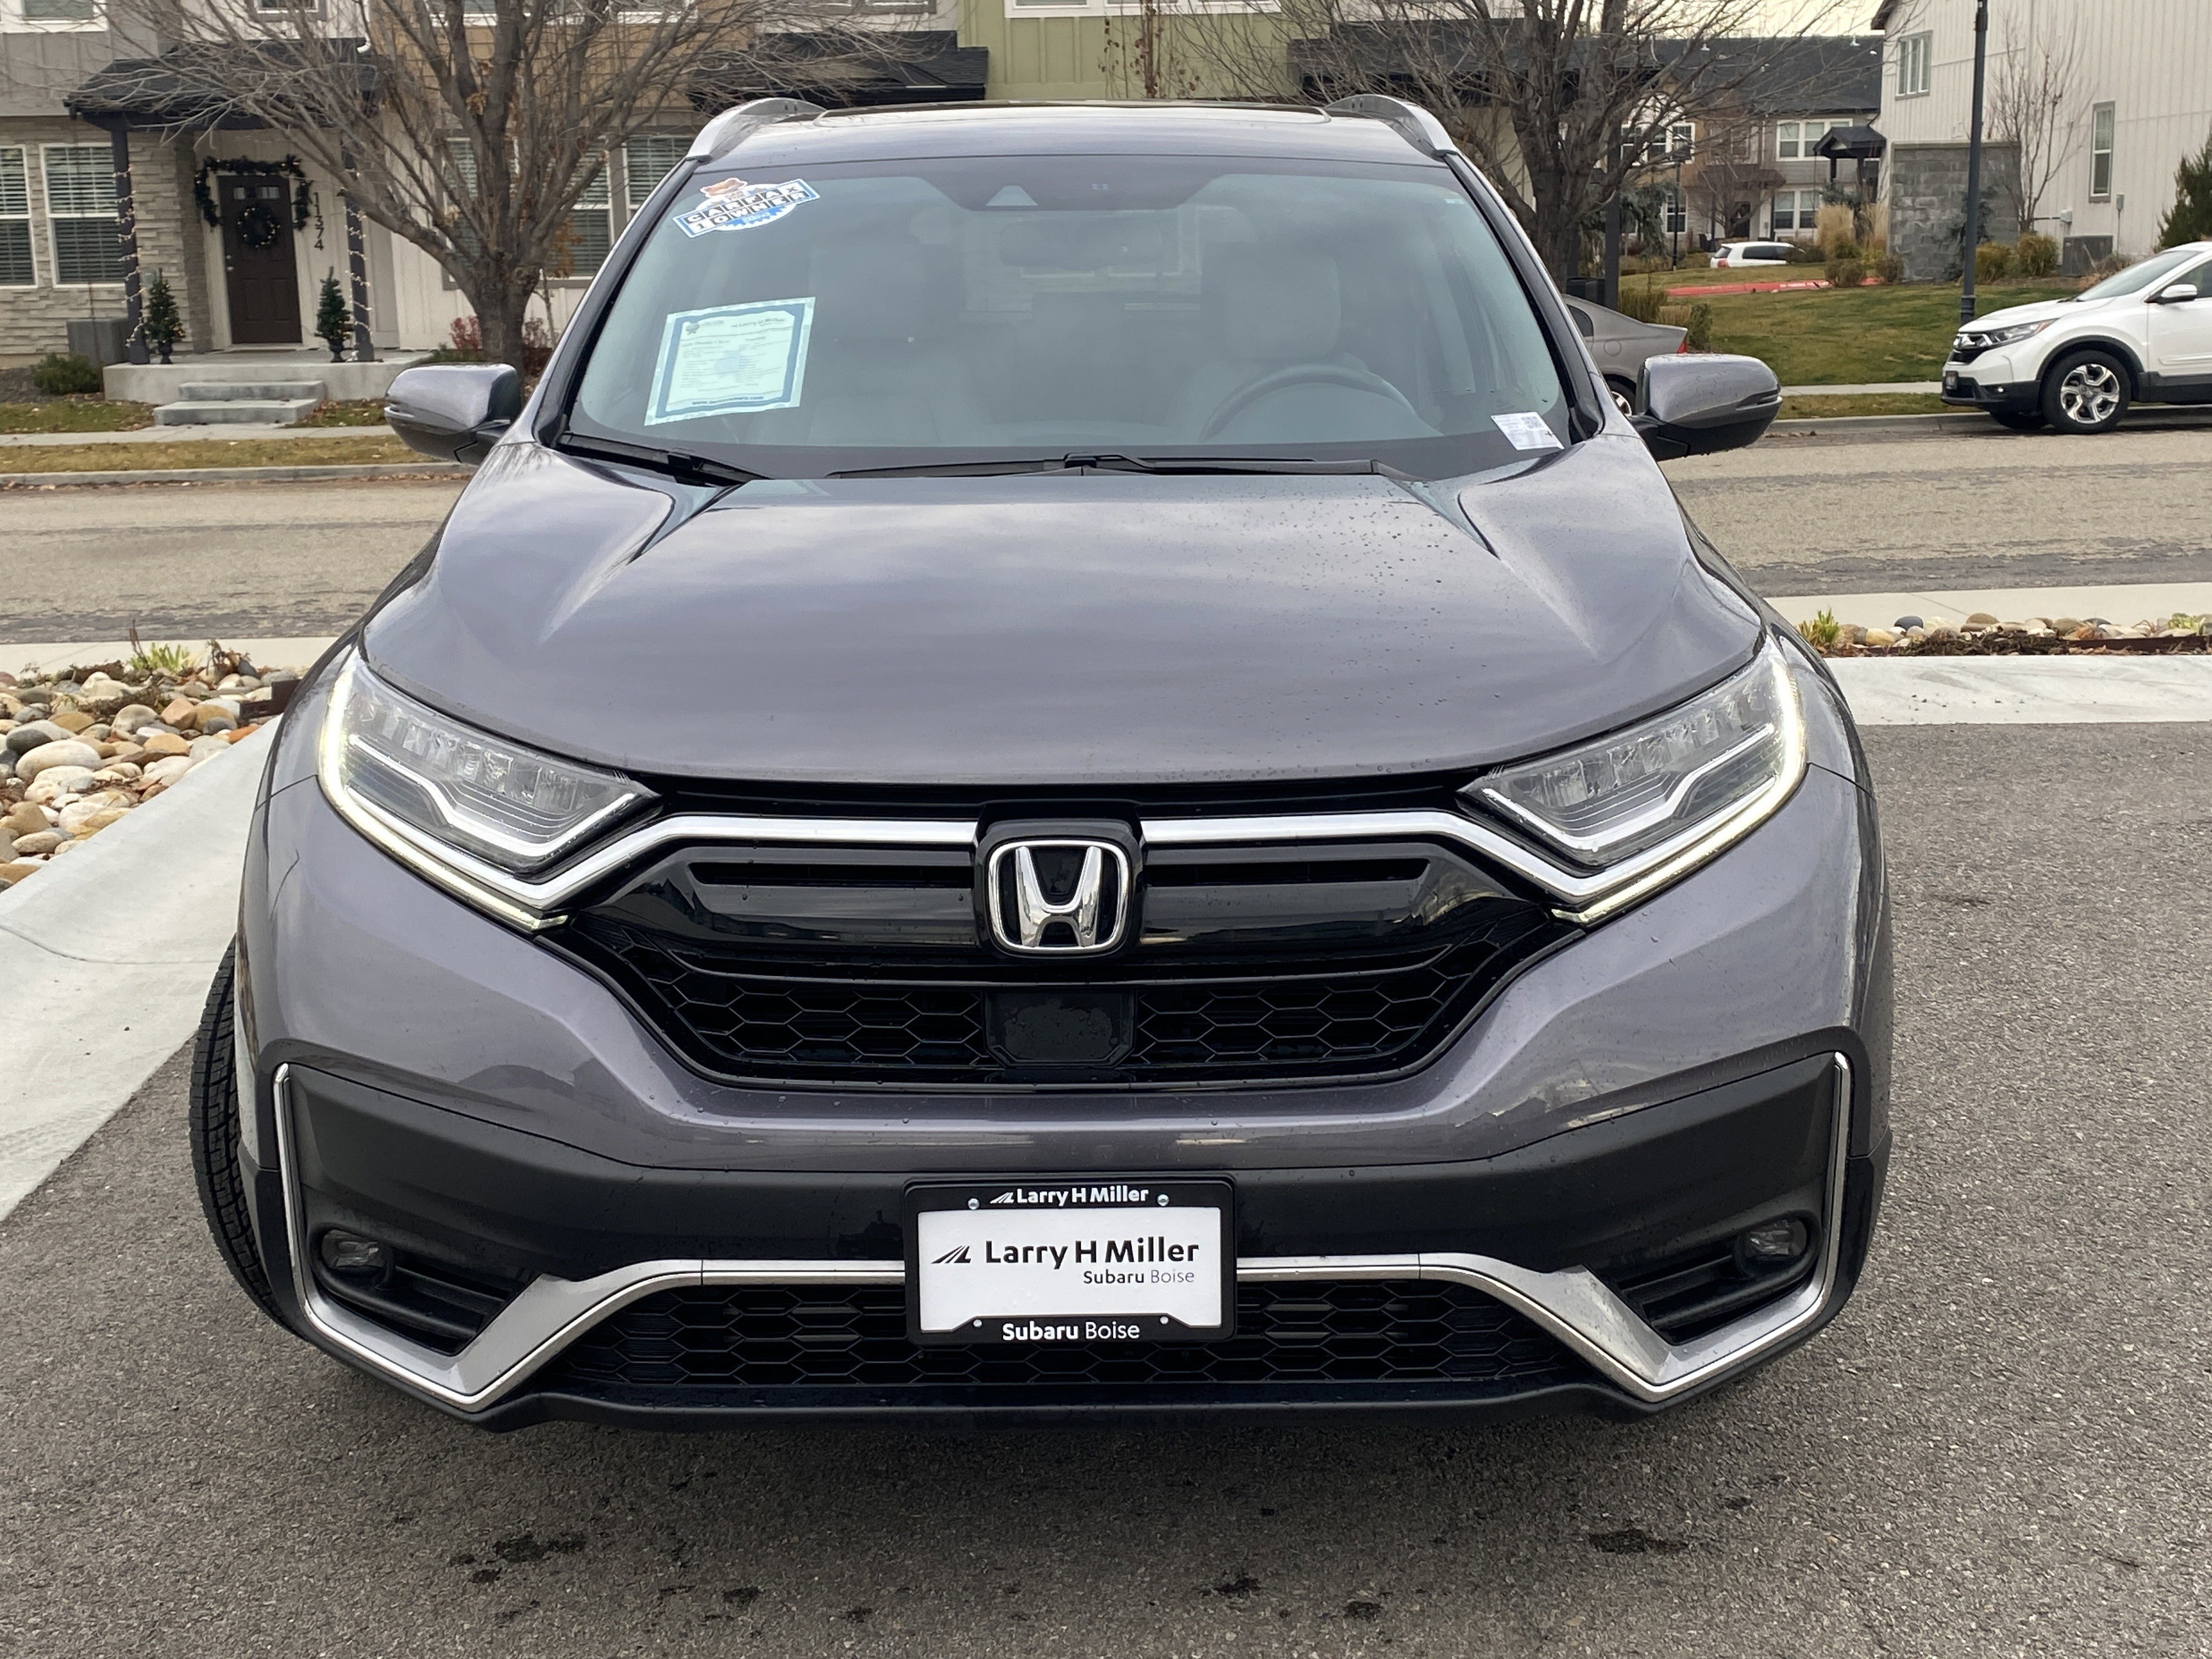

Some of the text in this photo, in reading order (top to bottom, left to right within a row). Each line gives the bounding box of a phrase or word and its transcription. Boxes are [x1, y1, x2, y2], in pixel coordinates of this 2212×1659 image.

[686, 187, 798, 223] CARFAX
[714, 192, 809, 225] OWNER
[313, 193, 324, 251] 11374
[1017, 1186, 1148, 1206] Larry H Miller
[986, 1236, 1199, 1269] Larry H Miller
[1084, 1269, 1195, 1283] Subaru Boise
[1003, 1321, 1140, 1340] Subaru Boise
